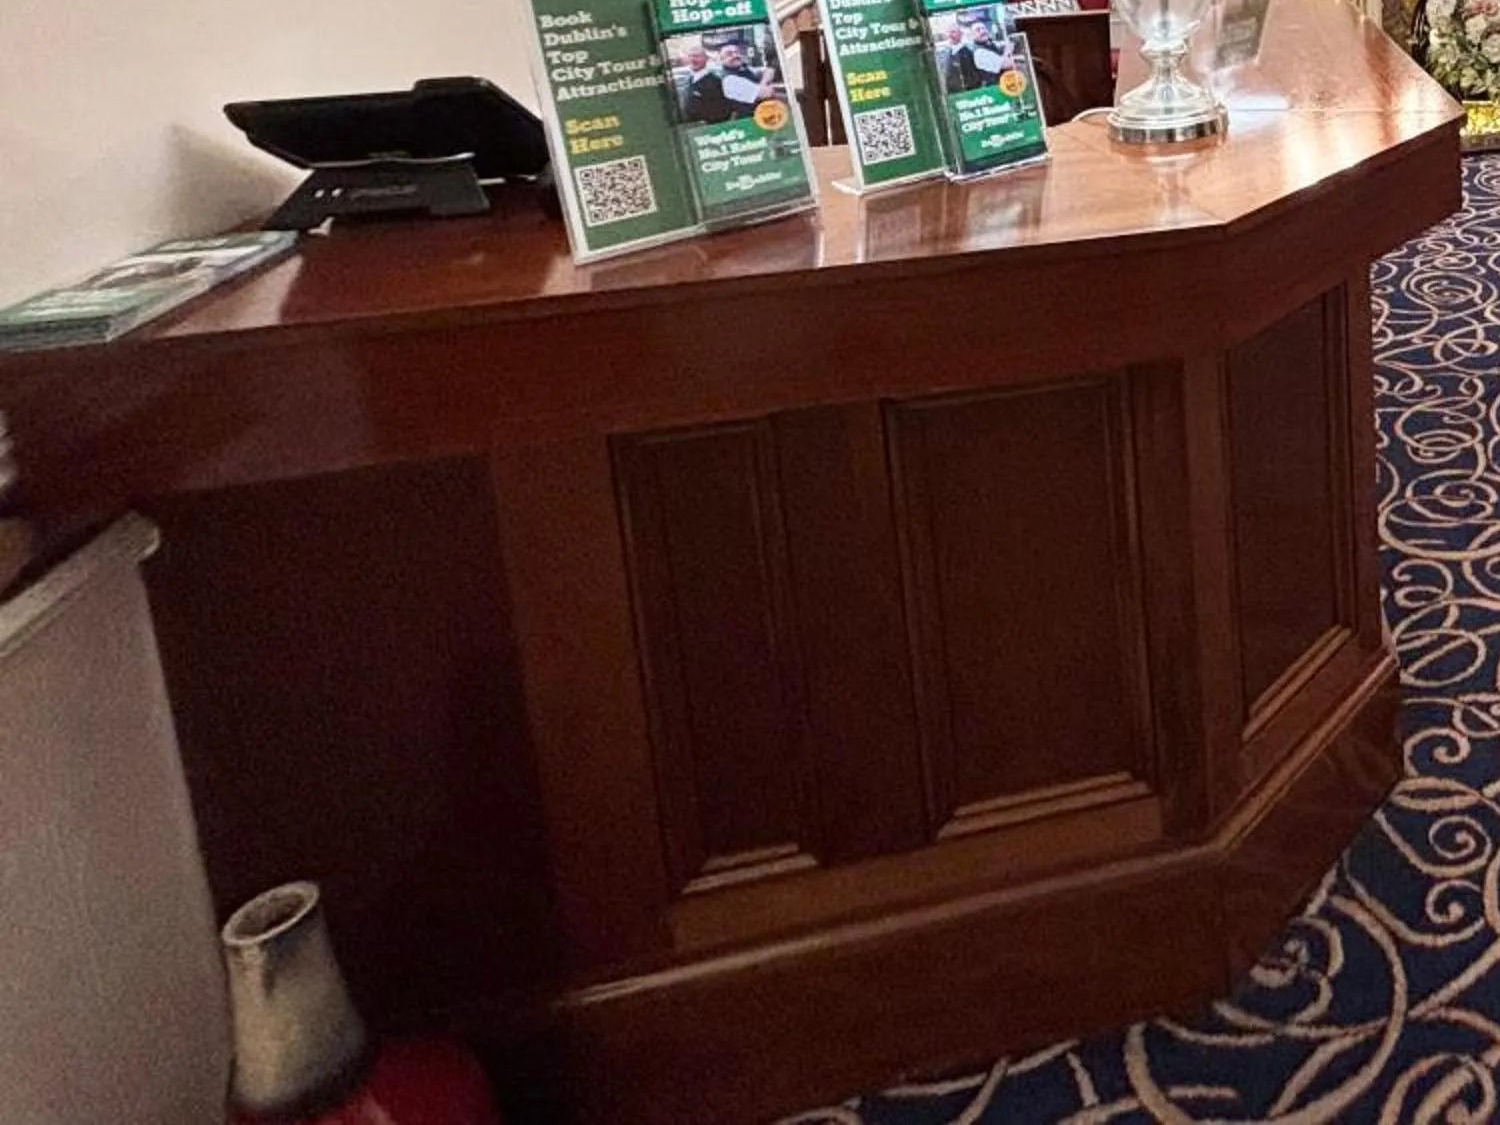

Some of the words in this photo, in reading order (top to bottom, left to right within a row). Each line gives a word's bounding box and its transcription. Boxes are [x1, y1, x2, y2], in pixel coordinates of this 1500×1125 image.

[540, 10, 592, 28] Book
[672, 1, 753, 24] Hop-off
[831, 13, 864, 25] Top
[543, 23, 628, 47] Dublin's
[836, 26, 869, 40] City
[546, 51, 590, 64] Top
[552, 66, 596, 82] City
[596, 60, 646, 75] Tour
[847, 70, 888, 86] Scan
[849, 86, 892, 103] Here
[564, 115, 621, 135] Scan
[570, 135, 624, 156] Here
